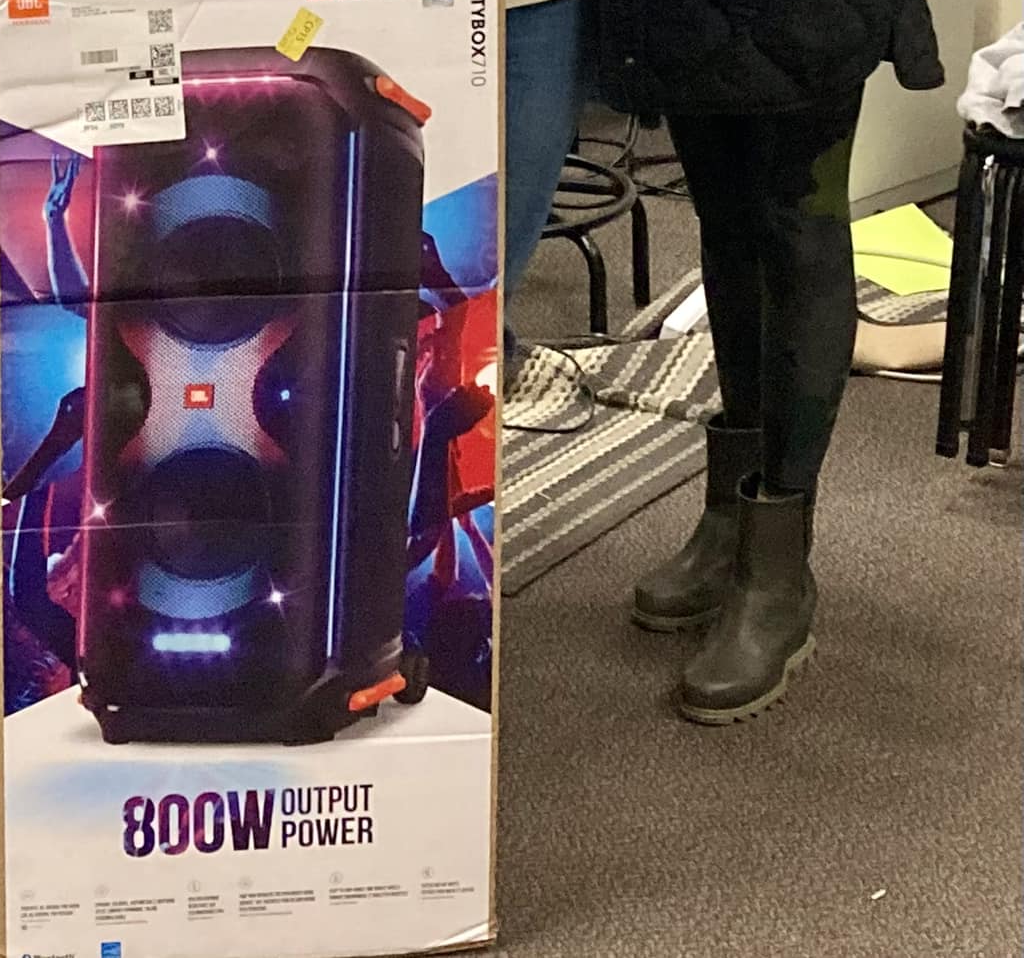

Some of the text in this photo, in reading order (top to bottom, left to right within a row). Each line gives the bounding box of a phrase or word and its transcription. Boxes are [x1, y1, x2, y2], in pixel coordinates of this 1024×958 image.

[281, 784, 373, 817] OUTPUT
[123, 788, 276, 858] 800W
[281, 816, 374, 849] POWER
